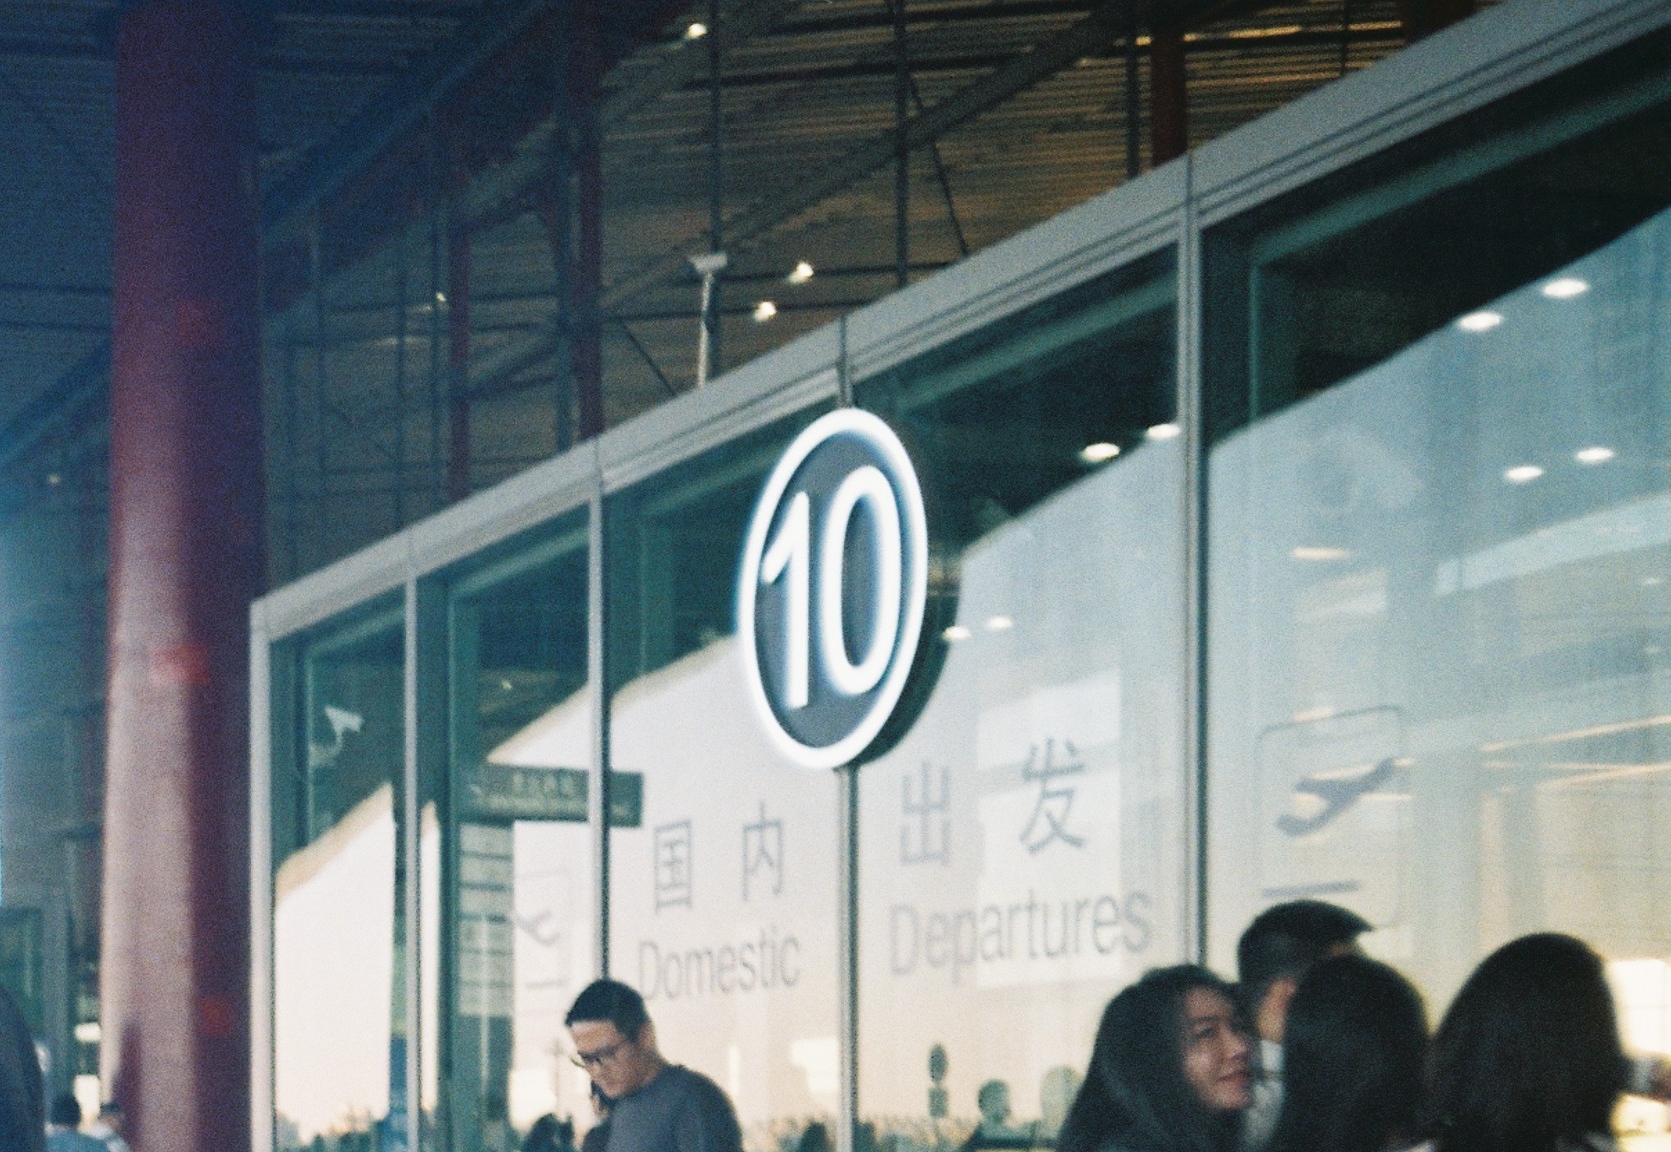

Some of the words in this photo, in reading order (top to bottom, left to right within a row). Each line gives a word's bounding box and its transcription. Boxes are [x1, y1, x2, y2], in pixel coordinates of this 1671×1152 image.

[760, 464, 902, 709] 10
[636, 924, 803, 1001] Domestic
[889, 886, 1154, 985] Departures
